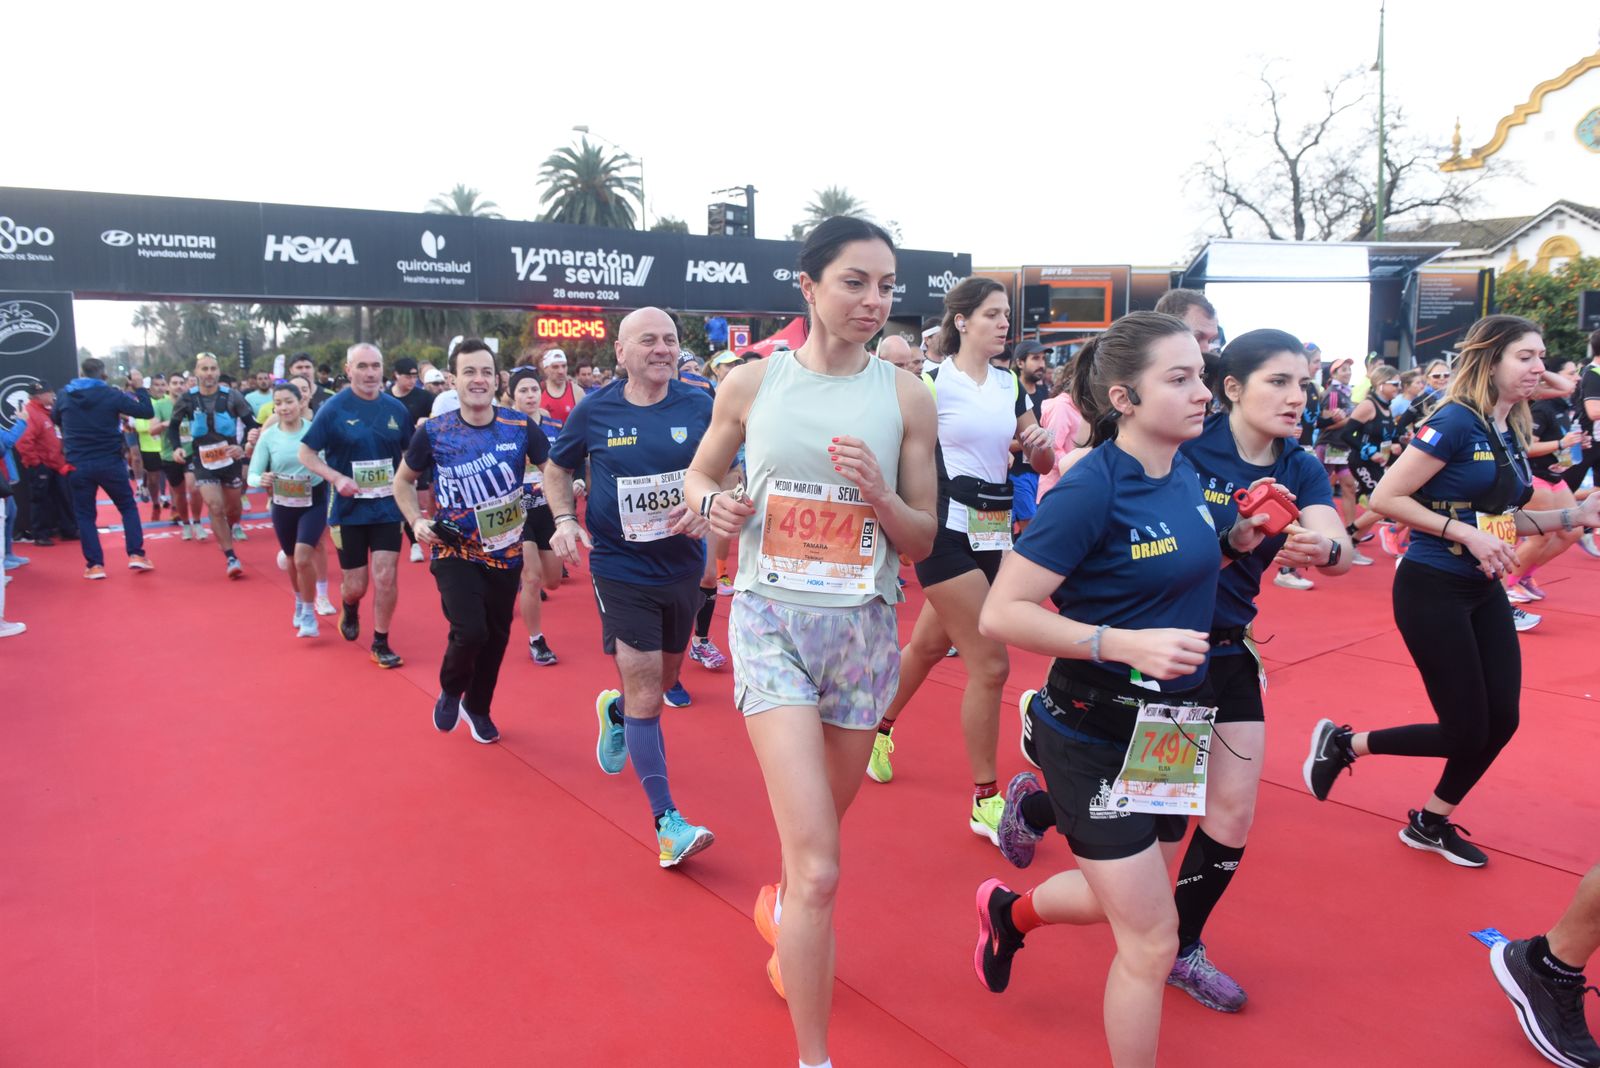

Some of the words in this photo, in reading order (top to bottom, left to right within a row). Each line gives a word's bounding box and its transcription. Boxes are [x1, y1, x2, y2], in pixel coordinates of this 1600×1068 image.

[137, 232, 216, 249] HYUNDAI
[264, 234, 356, 265] HOKA
[189, 250, 216, 260] Motor
[540, 248, 634, 269] maratón
[685, 260, 748, 284] HOKA
[553, 288, 566, 298] 28
[567, 290, 595, 300] enero
[596, 290, 620, 300] 2024
[537, 318, 606, 338] 00:02:45
[495, 442, 518, 451] HOKA
[607, 436, 638, 447] DRANCY
[360, 469, 386, 482] 7617
[454, 452, 498, 479] MARATÓN
[438, 461, 518, 509] SEVILLA
[661, 474, 681, 484] SEVILLA
[774, 479, 792, 492] MEDIO
[793, 481, 823, 495] MARATÓN
[624, 487, 685, 514] 14833
[486, 505, 519, 529] 7321
[780, 507, 855, 542] 4974
[1130, 528, 1141, 543] A
[1145, 525, 1158, 538] S
[1159, 521, 1171, 535] C
[803, 542, 829, 551] TAMARA
[1131, 536, 1179, 560] DRANCY
[1140, 731, 1197, 765] 7497
